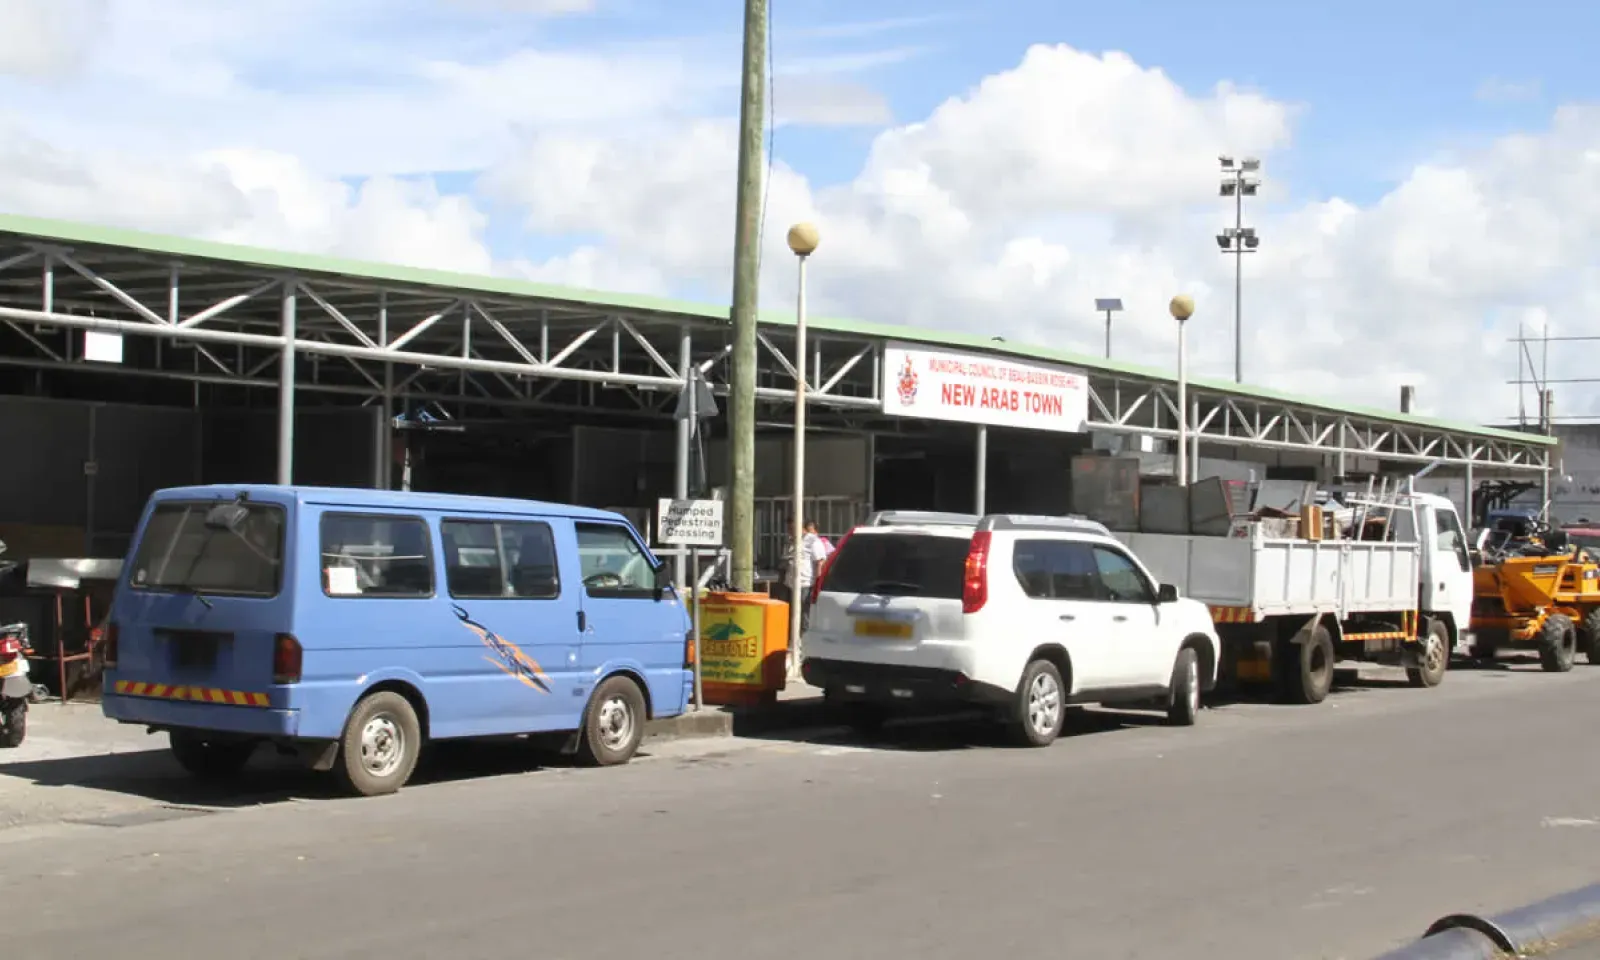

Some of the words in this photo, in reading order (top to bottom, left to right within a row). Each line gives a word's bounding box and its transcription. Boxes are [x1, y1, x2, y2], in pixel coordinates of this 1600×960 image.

[968, 363, 996, 380] COUNCIL
[998, 367, 1007, 381] OF
[941, 383, 975, 407] NEW
[980, 387, 1019, 413] ARAB
[1023, 392, 1063, 417] TOWN
[668, 505, 714, 517] Humped
[660, 516, 720, 528] Pedestrian
[665, 527, 715, 540] Crossing
